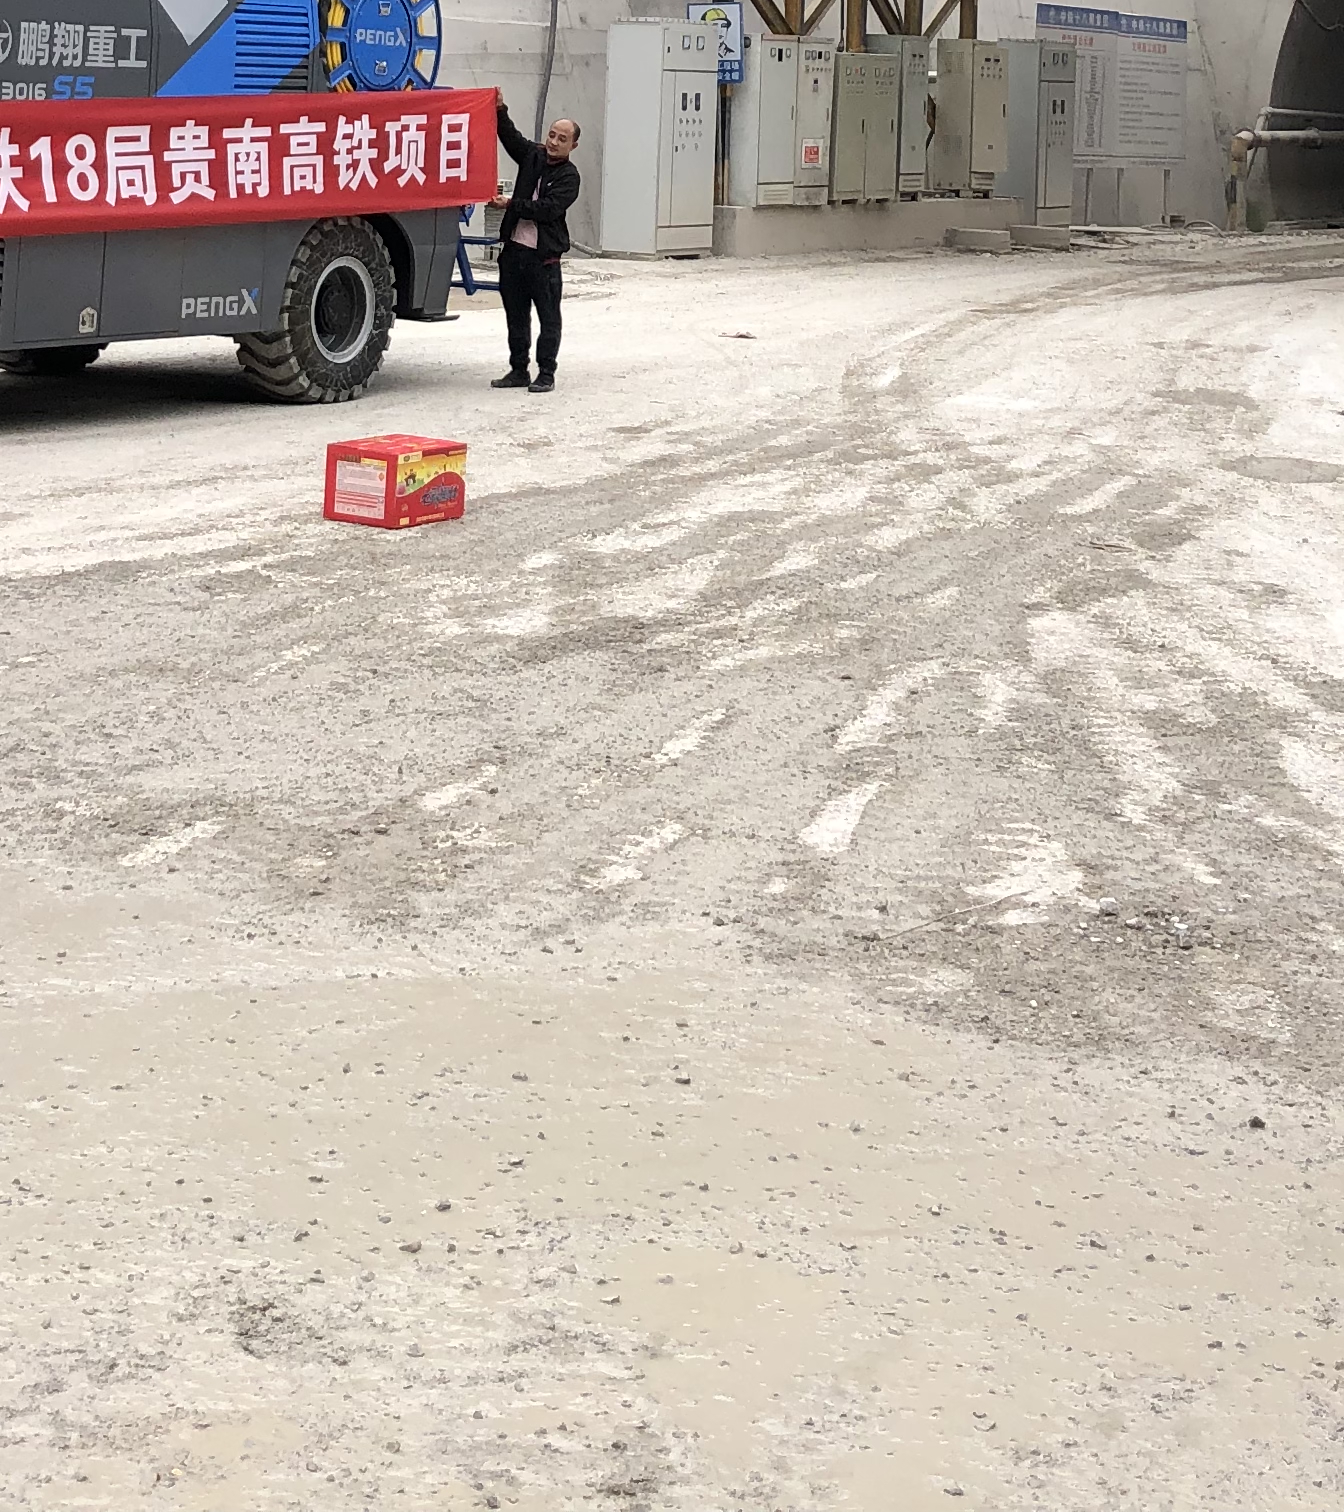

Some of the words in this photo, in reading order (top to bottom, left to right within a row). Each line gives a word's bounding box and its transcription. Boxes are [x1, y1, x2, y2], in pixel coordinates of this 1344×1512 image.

[17, 20, 148, 68] 鹏翔重工
[181, 288, 259, 319] PENGX
